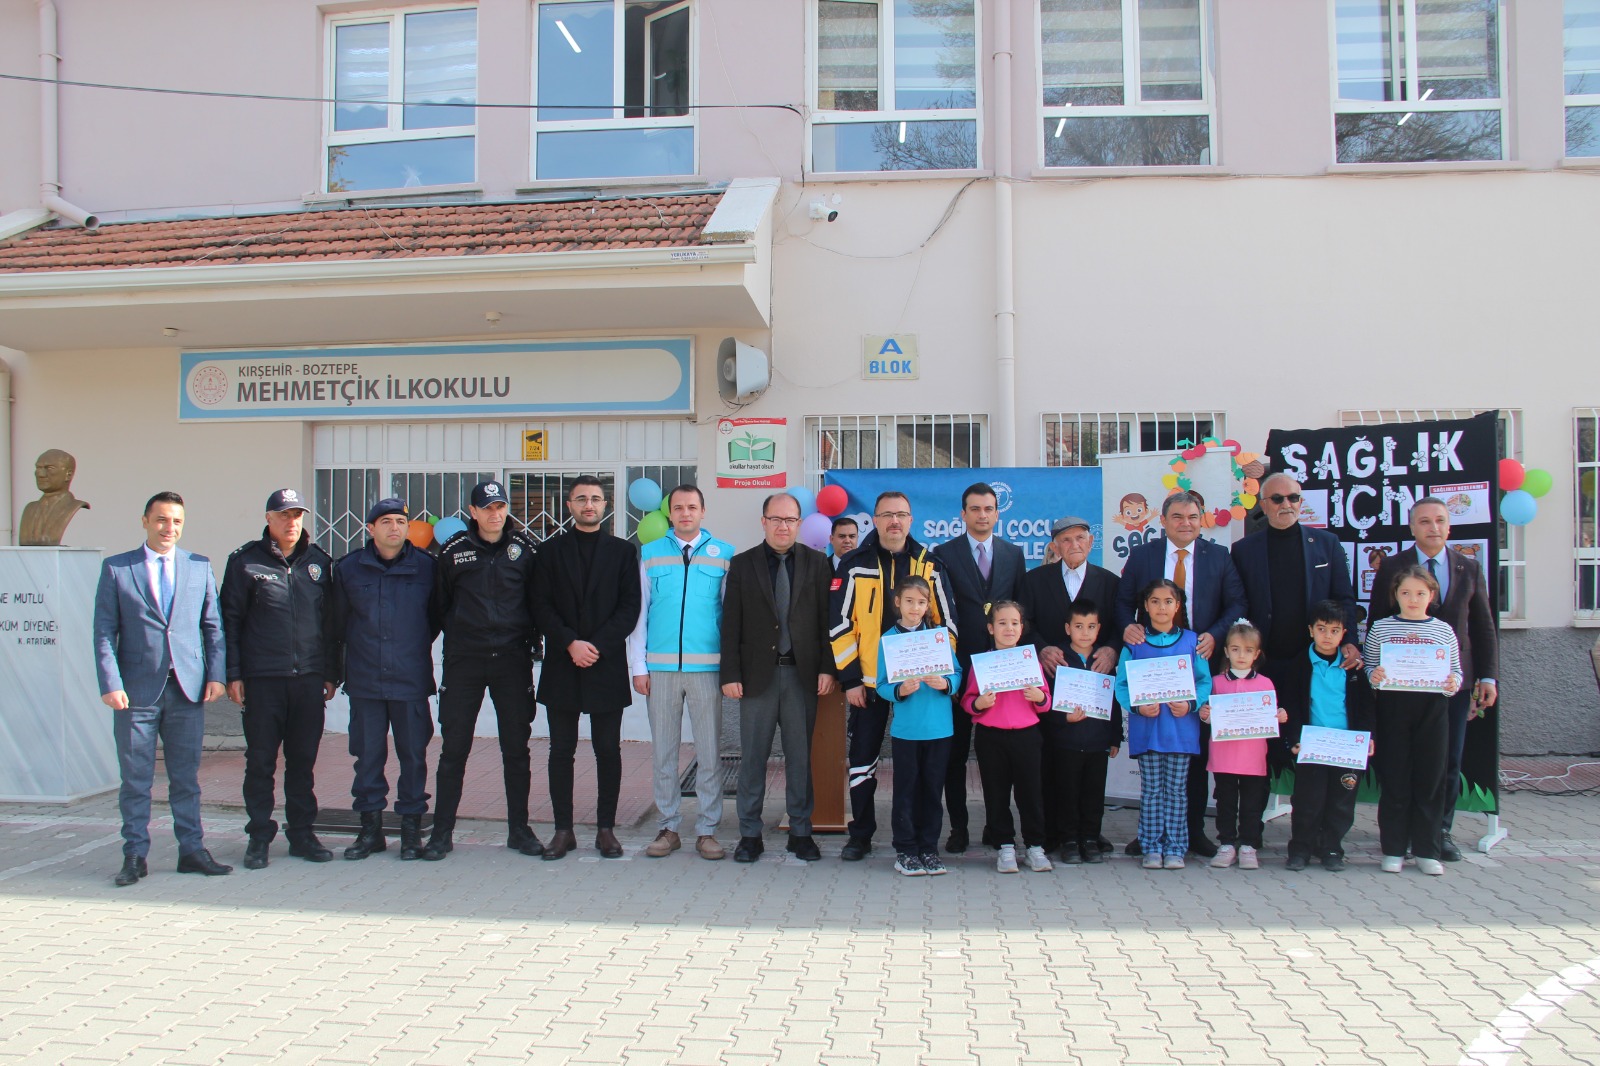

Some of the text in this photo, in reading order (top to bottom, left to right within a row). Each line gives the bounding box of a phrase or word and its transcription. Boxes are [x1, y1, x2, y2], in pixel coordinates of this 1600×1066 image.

[879, 338, 903, 354] A
[238, 363, 293, 380] KIRŞEHİR
[303, 363, 358, 376] BOZTEPE
[869, 360, 912, 374] BLOK
[237, 375, 380, 407] MEHMETÇİK
[387, 374, 510, 400] İLKOKULU
[1282, 430, 1465, 482] SAĞLIK
[1331, 478, 1424, 540] İÇİN
[14, 592, 44, 604] MUTLU
[26, 635, 56, 645] ATATÜRK
